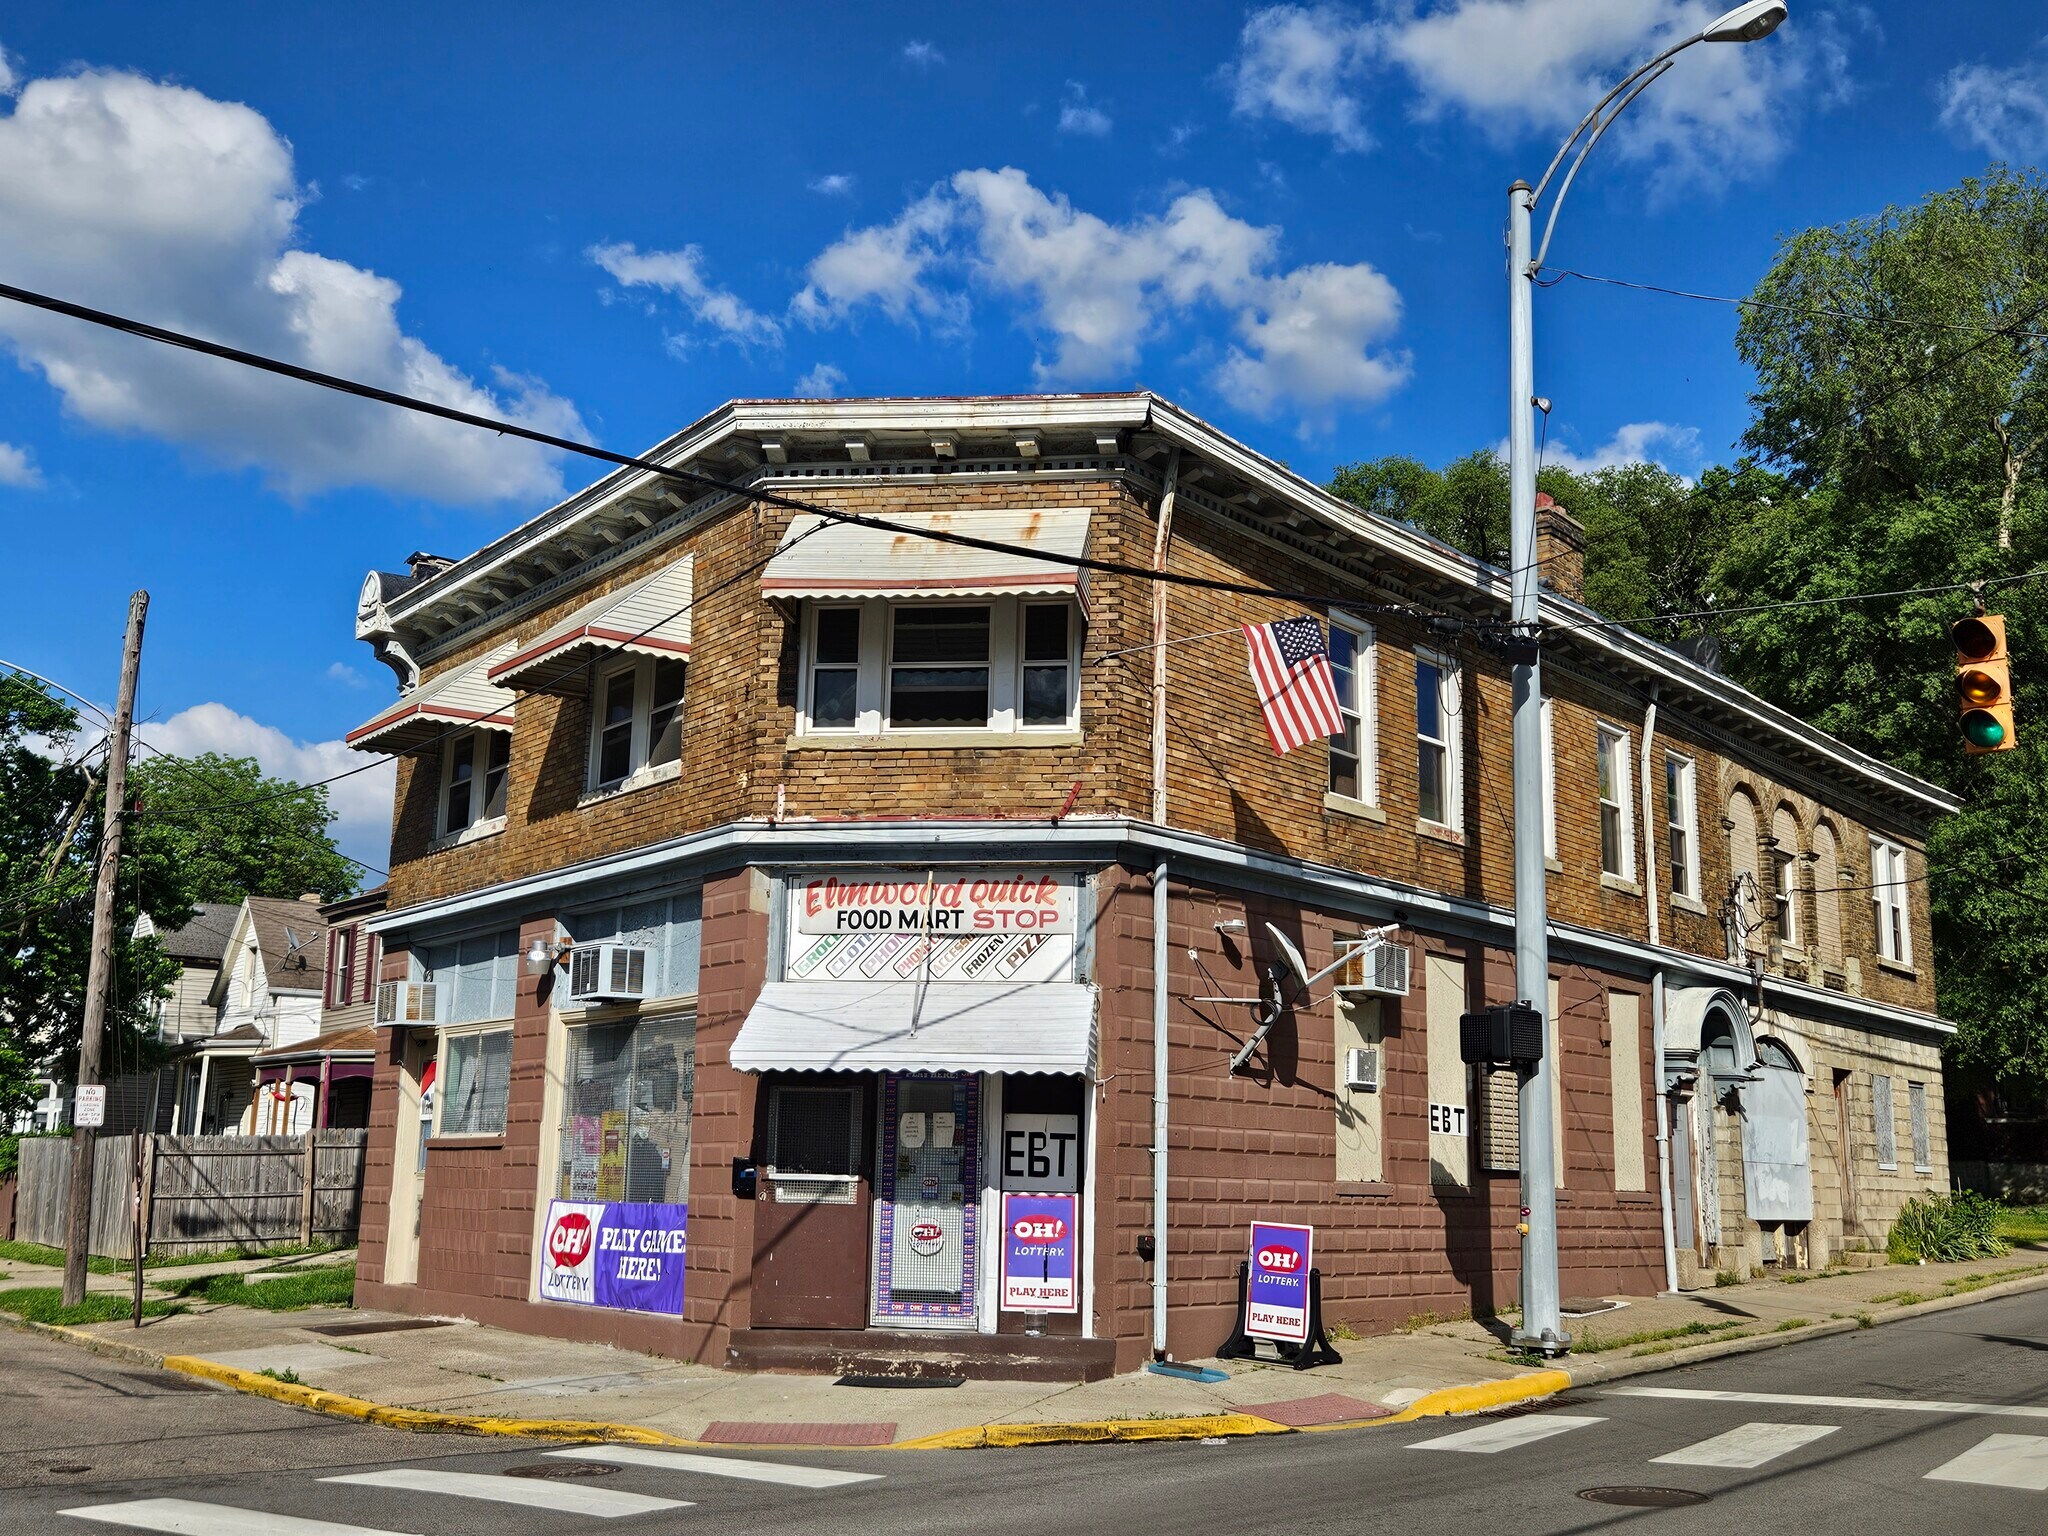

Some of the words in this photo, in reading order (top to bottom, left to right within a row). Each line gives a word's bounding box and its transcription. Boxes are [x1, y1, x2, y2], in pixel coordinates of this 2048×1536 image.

[805, 877, 966, 918] Elmwood
[970, 874, 1059, 908] Quick
[837, 909, 891, 929] FOOD
[898, 909, 964, 929] MART
[973, 909, 1059, 929] STOP
[966, 934, 1004, 975] FROZEN
[1430, 1104, 1465, 1134] EBT
[1005, 1131, 1076, 1178] EBT
[552, 1224, 591, 1255] OH!
[1014, 1219, 1063, 1238] OH!
[617, 1256, 662, 1281] HERE!
[1258, 1251, 1299, 1269] OH!
[1009, 1287, 1037, 1298] PLAY
[1040, 1288, 1069, 1298] HERE
[1252, 1312, 1275, 1324] PLAY
[1276, 1315, 1301, 1327] HERE
